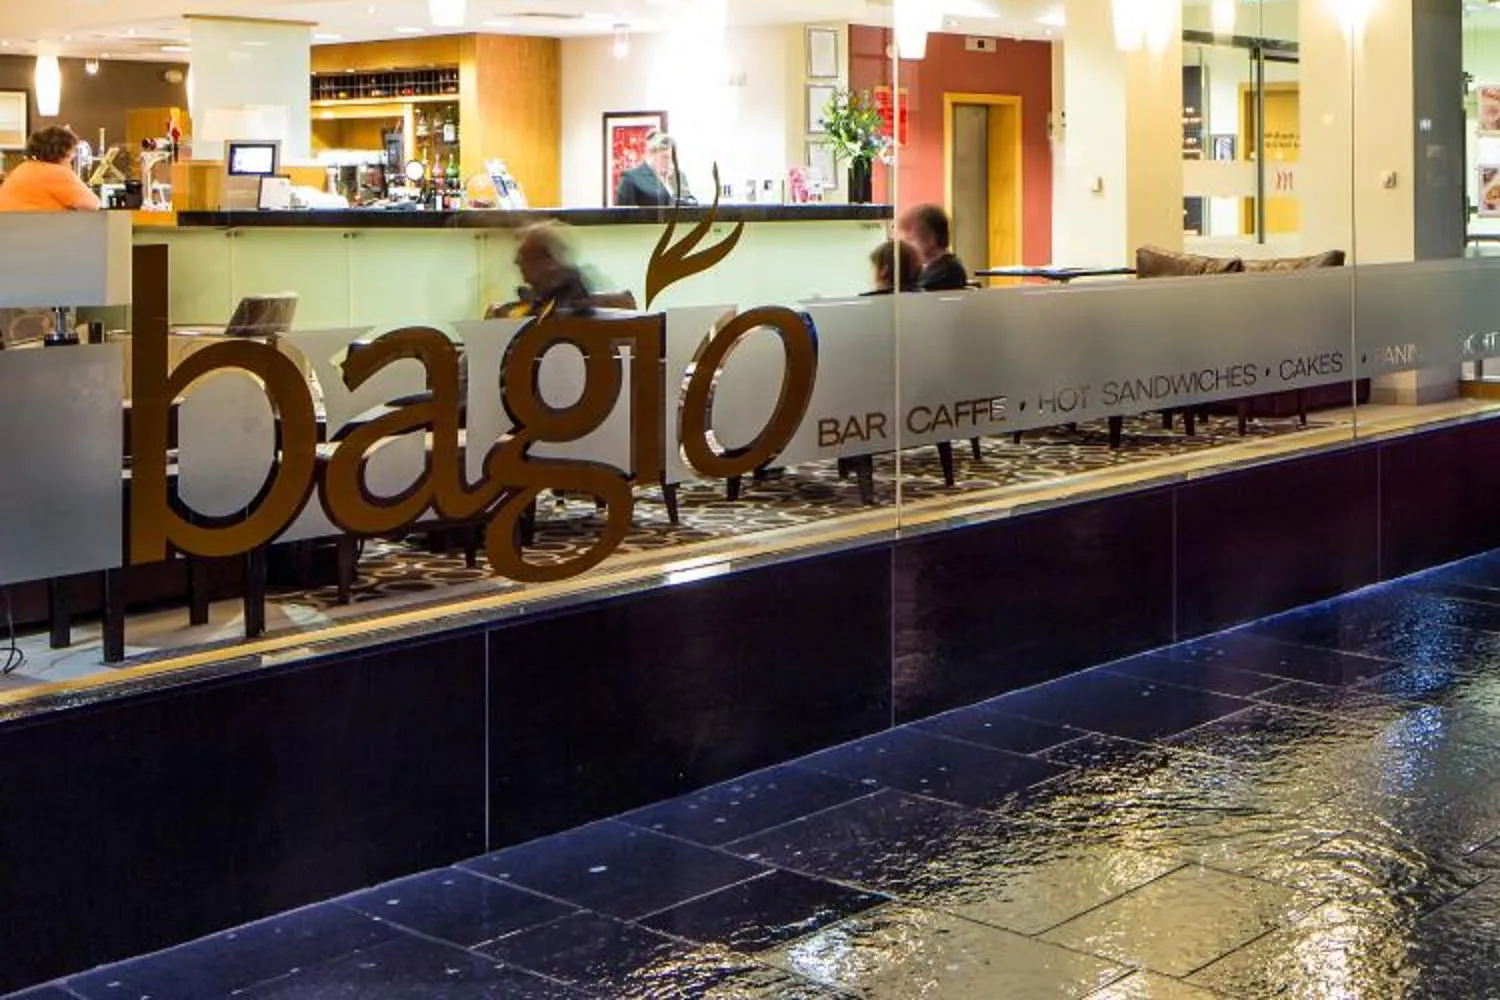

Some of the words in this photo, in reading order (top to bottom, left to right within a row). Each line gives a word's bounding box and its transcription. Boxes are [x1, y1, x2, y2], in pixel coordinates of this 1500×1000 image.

[817, 411, 887, 449] BAR
[1037, 384, 1092, 415] HOT
[1102, 362, 1258, 406] SANDWICHES
[1279, 350, 1344, 382] CAKES
